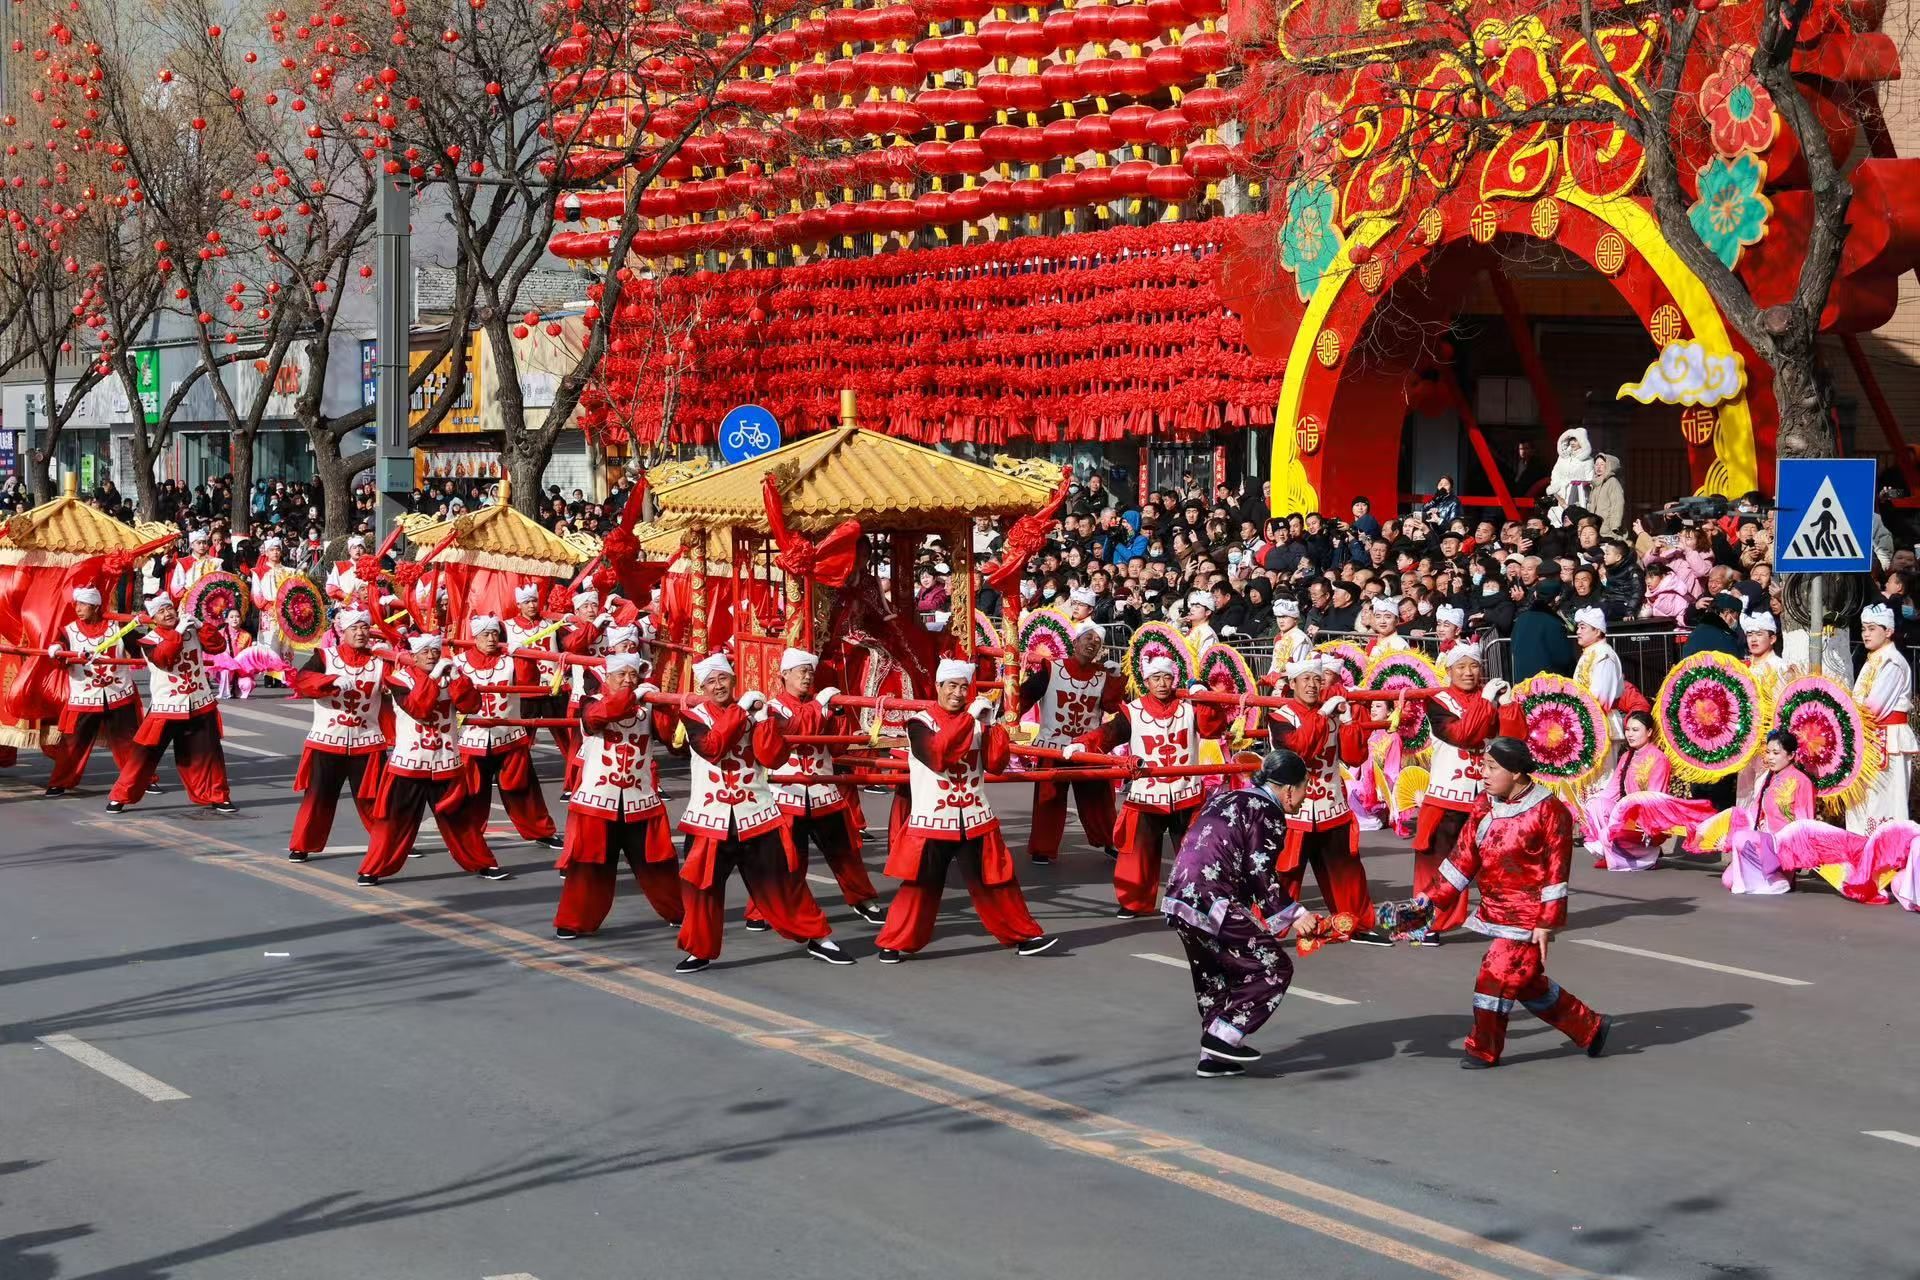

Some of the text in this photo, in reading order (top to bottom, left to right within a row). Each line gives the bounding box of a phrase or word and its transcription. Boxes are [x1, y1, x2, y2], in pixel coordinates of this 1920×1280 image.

[1470, 203, 1497, 243] 福
[1296, 415, 1319, 453] 福
[1681, 407, 1713, 444] 福
